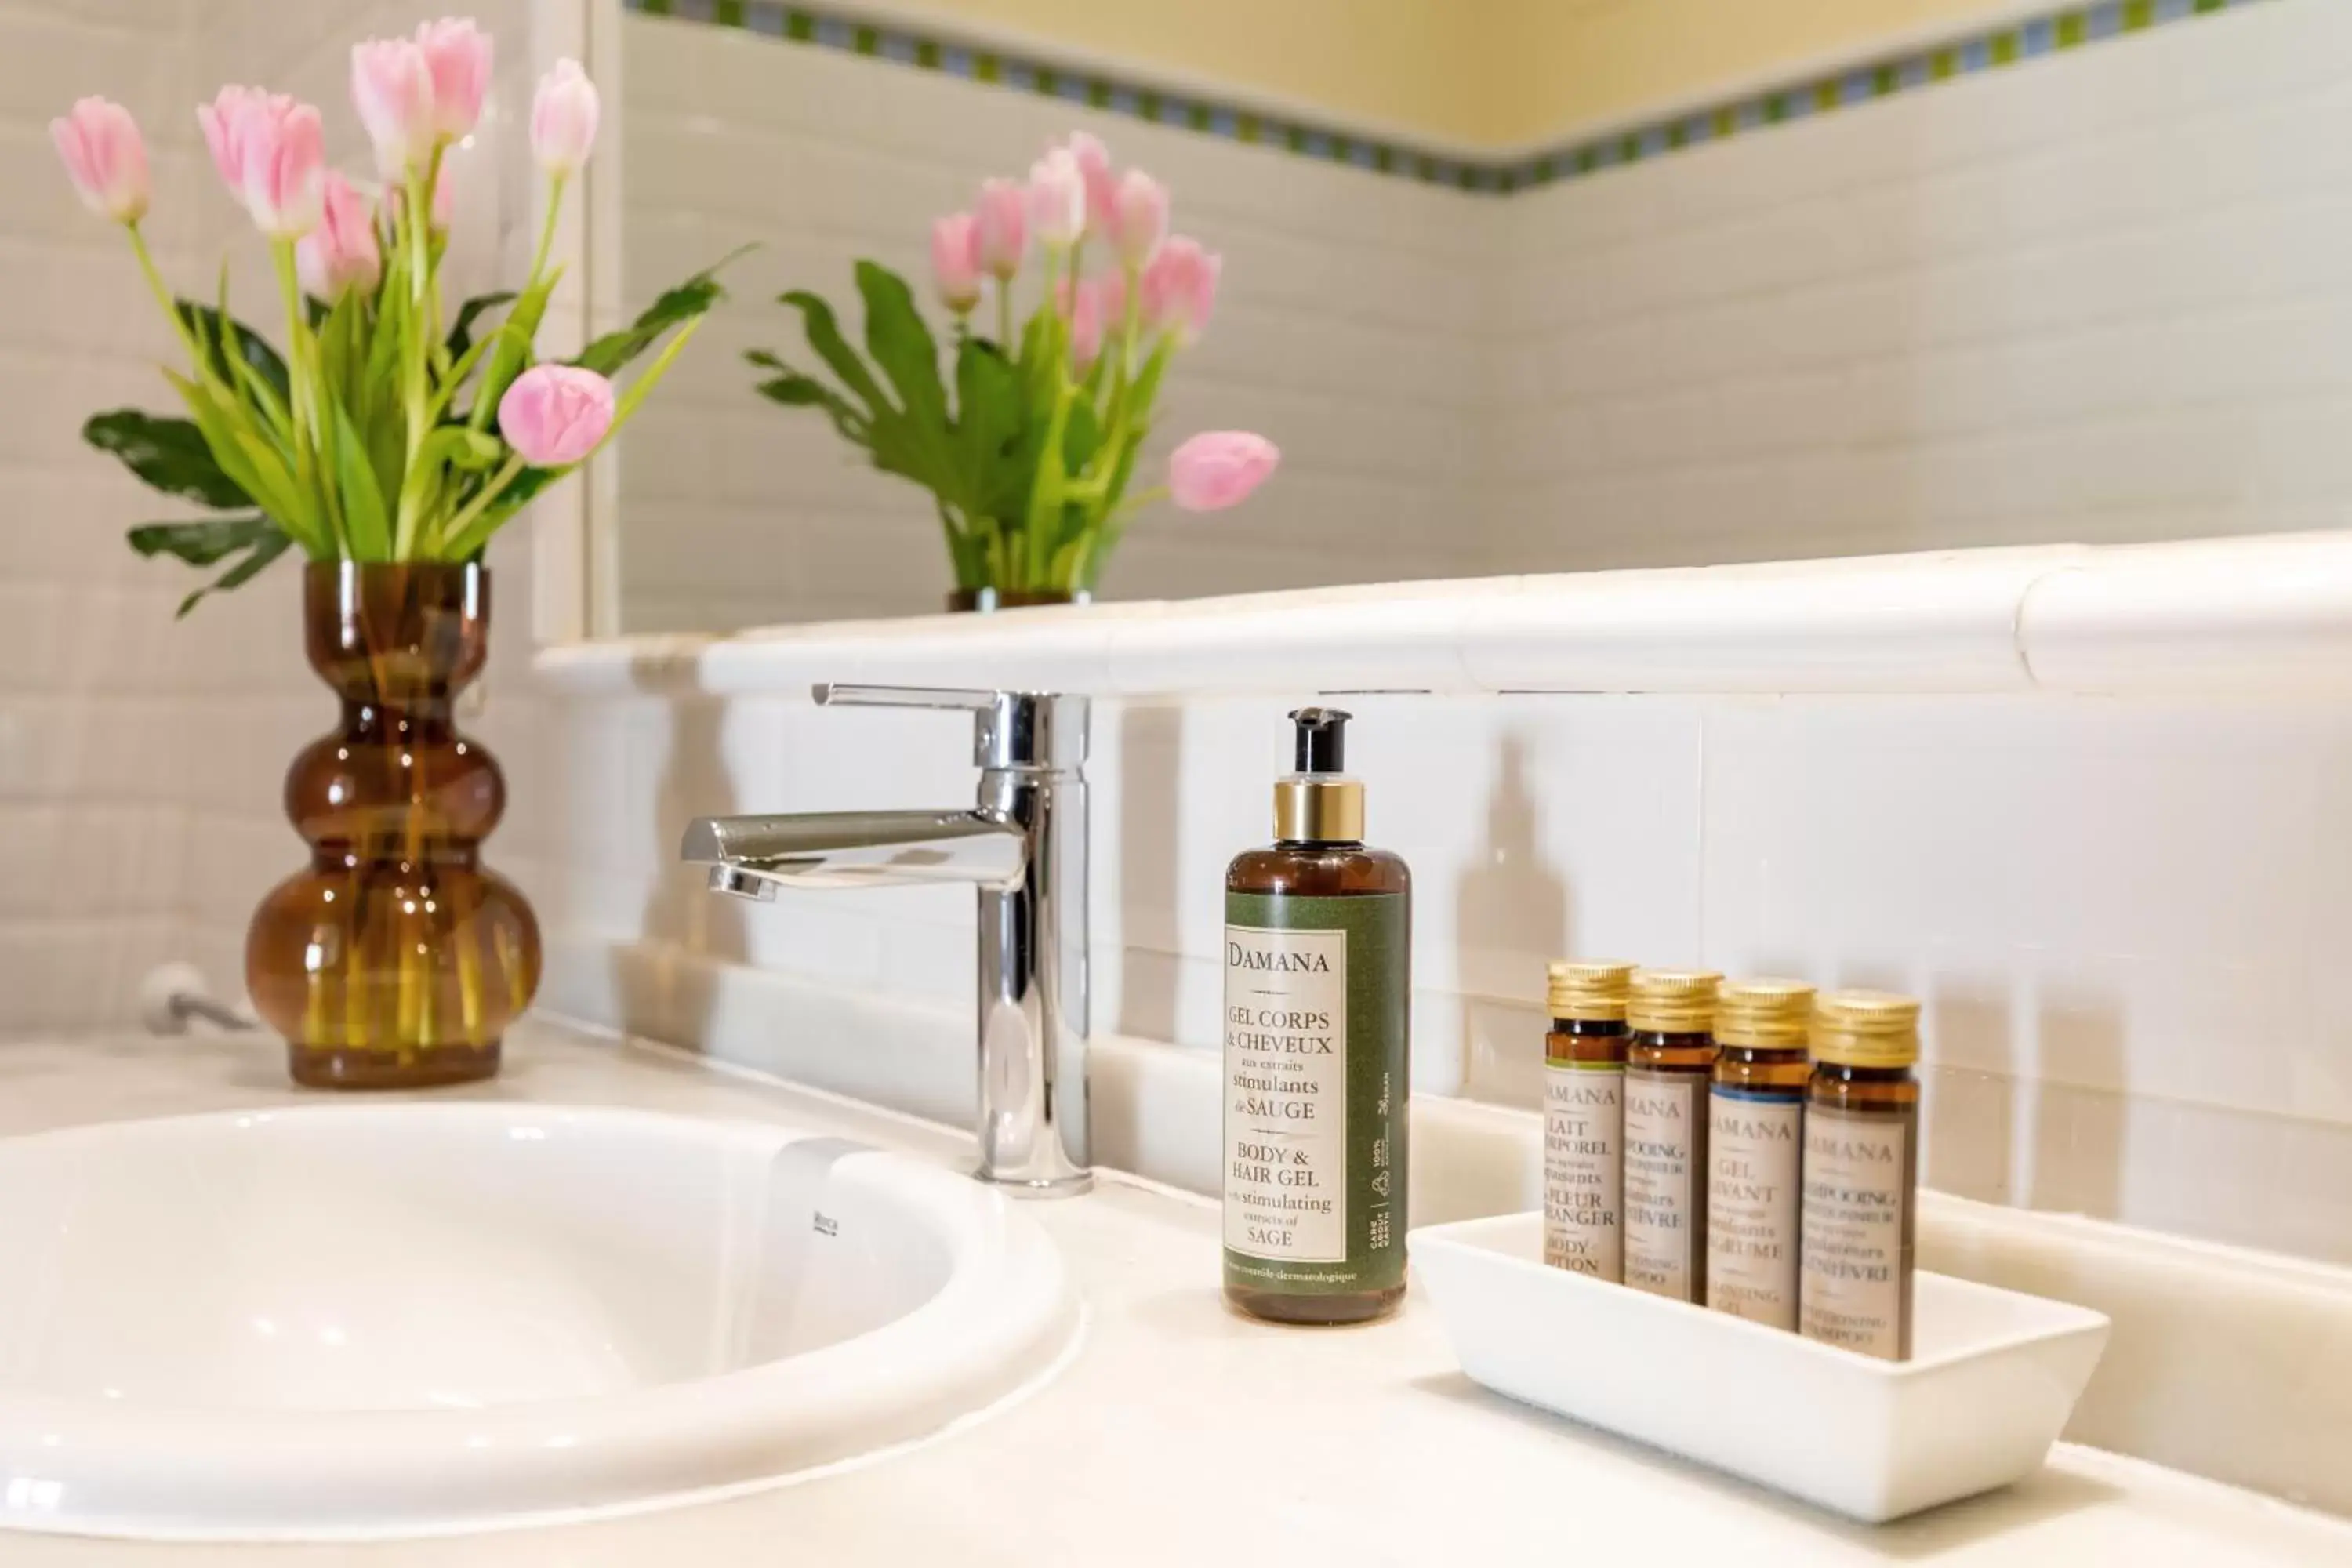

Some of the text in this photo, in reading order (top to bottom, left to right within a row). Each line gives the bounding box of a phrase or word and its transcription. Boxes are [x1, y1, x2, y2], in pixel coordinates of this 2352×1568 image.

[1229, 942, 1330, 973] DAMANA
[1228, 1005, 1330, 1031] GEL CORPS
[1238, 1031, 1333, 1054] CHEVEUX
[1233, 1071, 1319, 1094] stimulants
[1246, 1098, 1316, 1120] SAUGE
[1549, 1116, 1590, 1137] LAIT
[1237, 1141, 1310, 1166] BODY &
[1232, 1162, 1320, 1188] HAIR GEL
[1241, 1190, 1332, 1214] stimulating
[1247, 1228, 1293, 1247] SAGE
